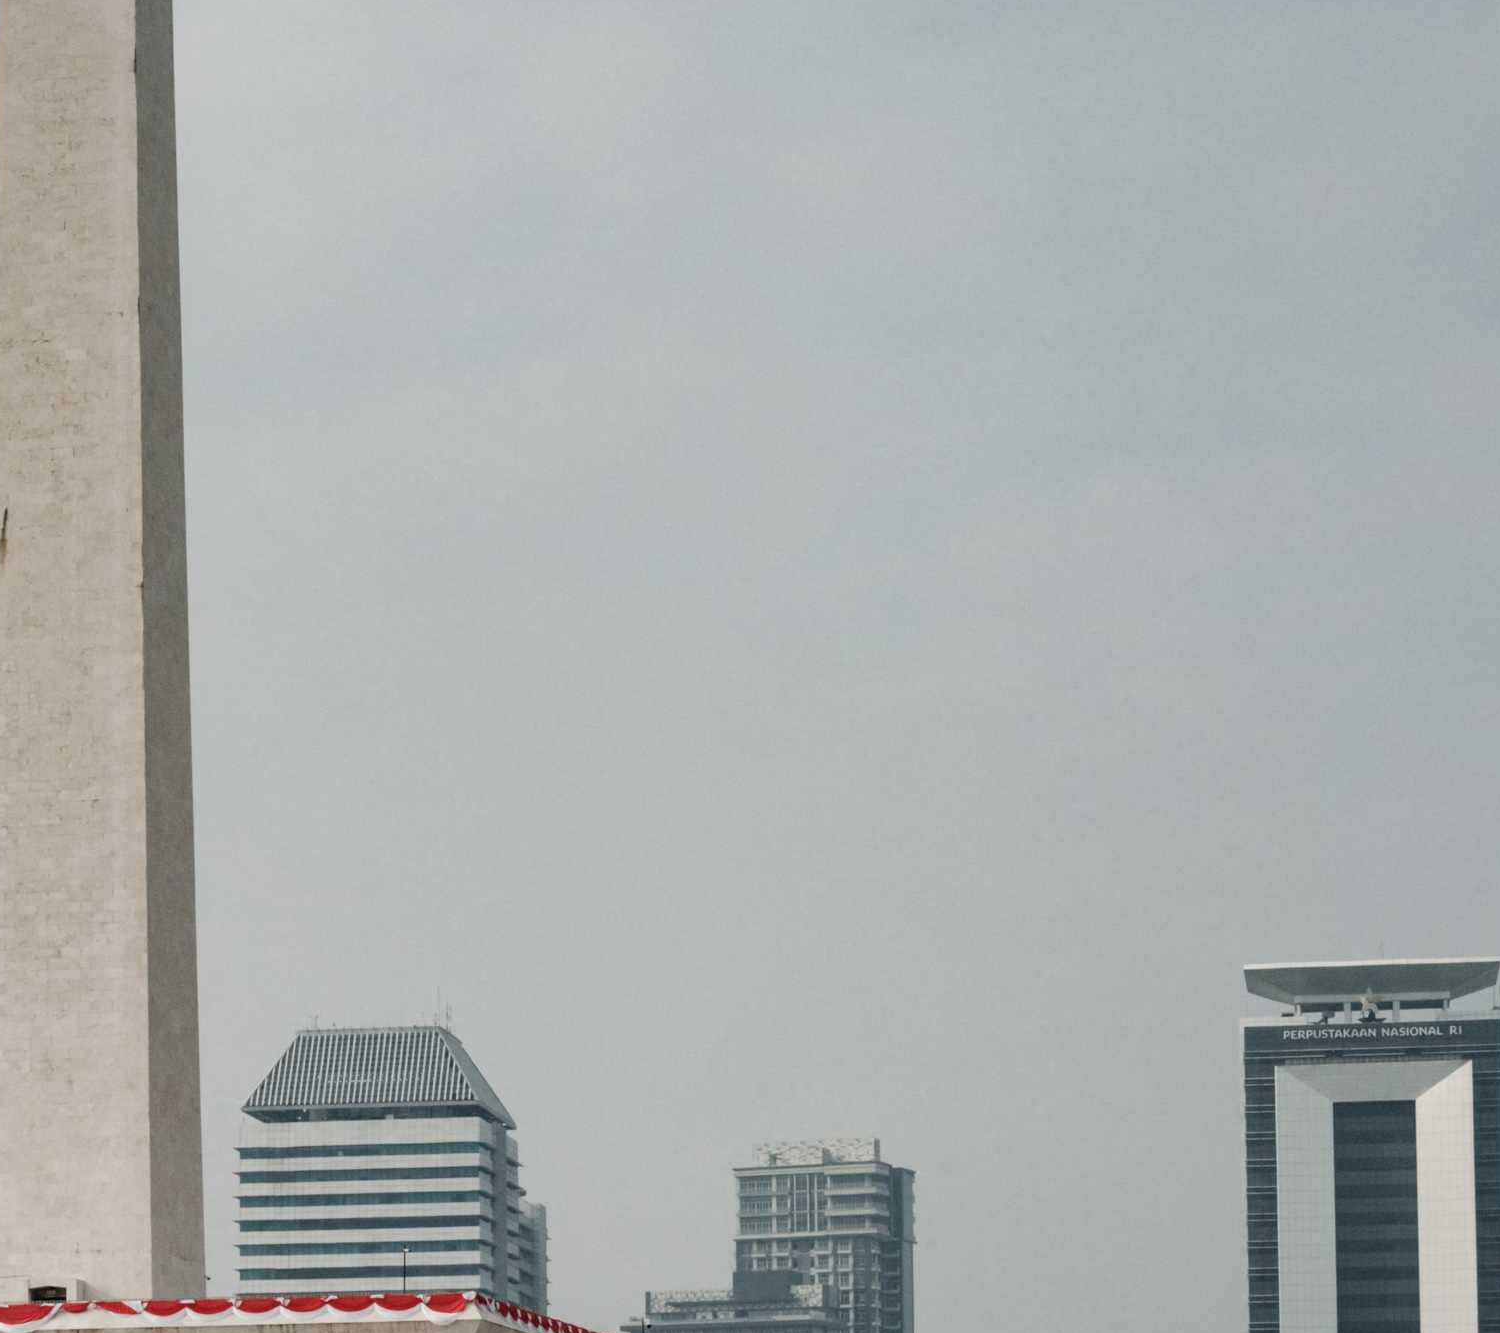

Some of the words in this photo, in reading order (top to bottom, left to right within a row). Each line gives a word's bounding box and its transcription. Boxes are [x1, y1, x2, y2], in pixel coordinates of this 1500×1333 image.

[1282, 1028, 1377, 1040] PERPUSTAKAAN
[1381, 1025, 1443, 1037] NASIONAL
[1449, 1025, 1463, 1035] RI
